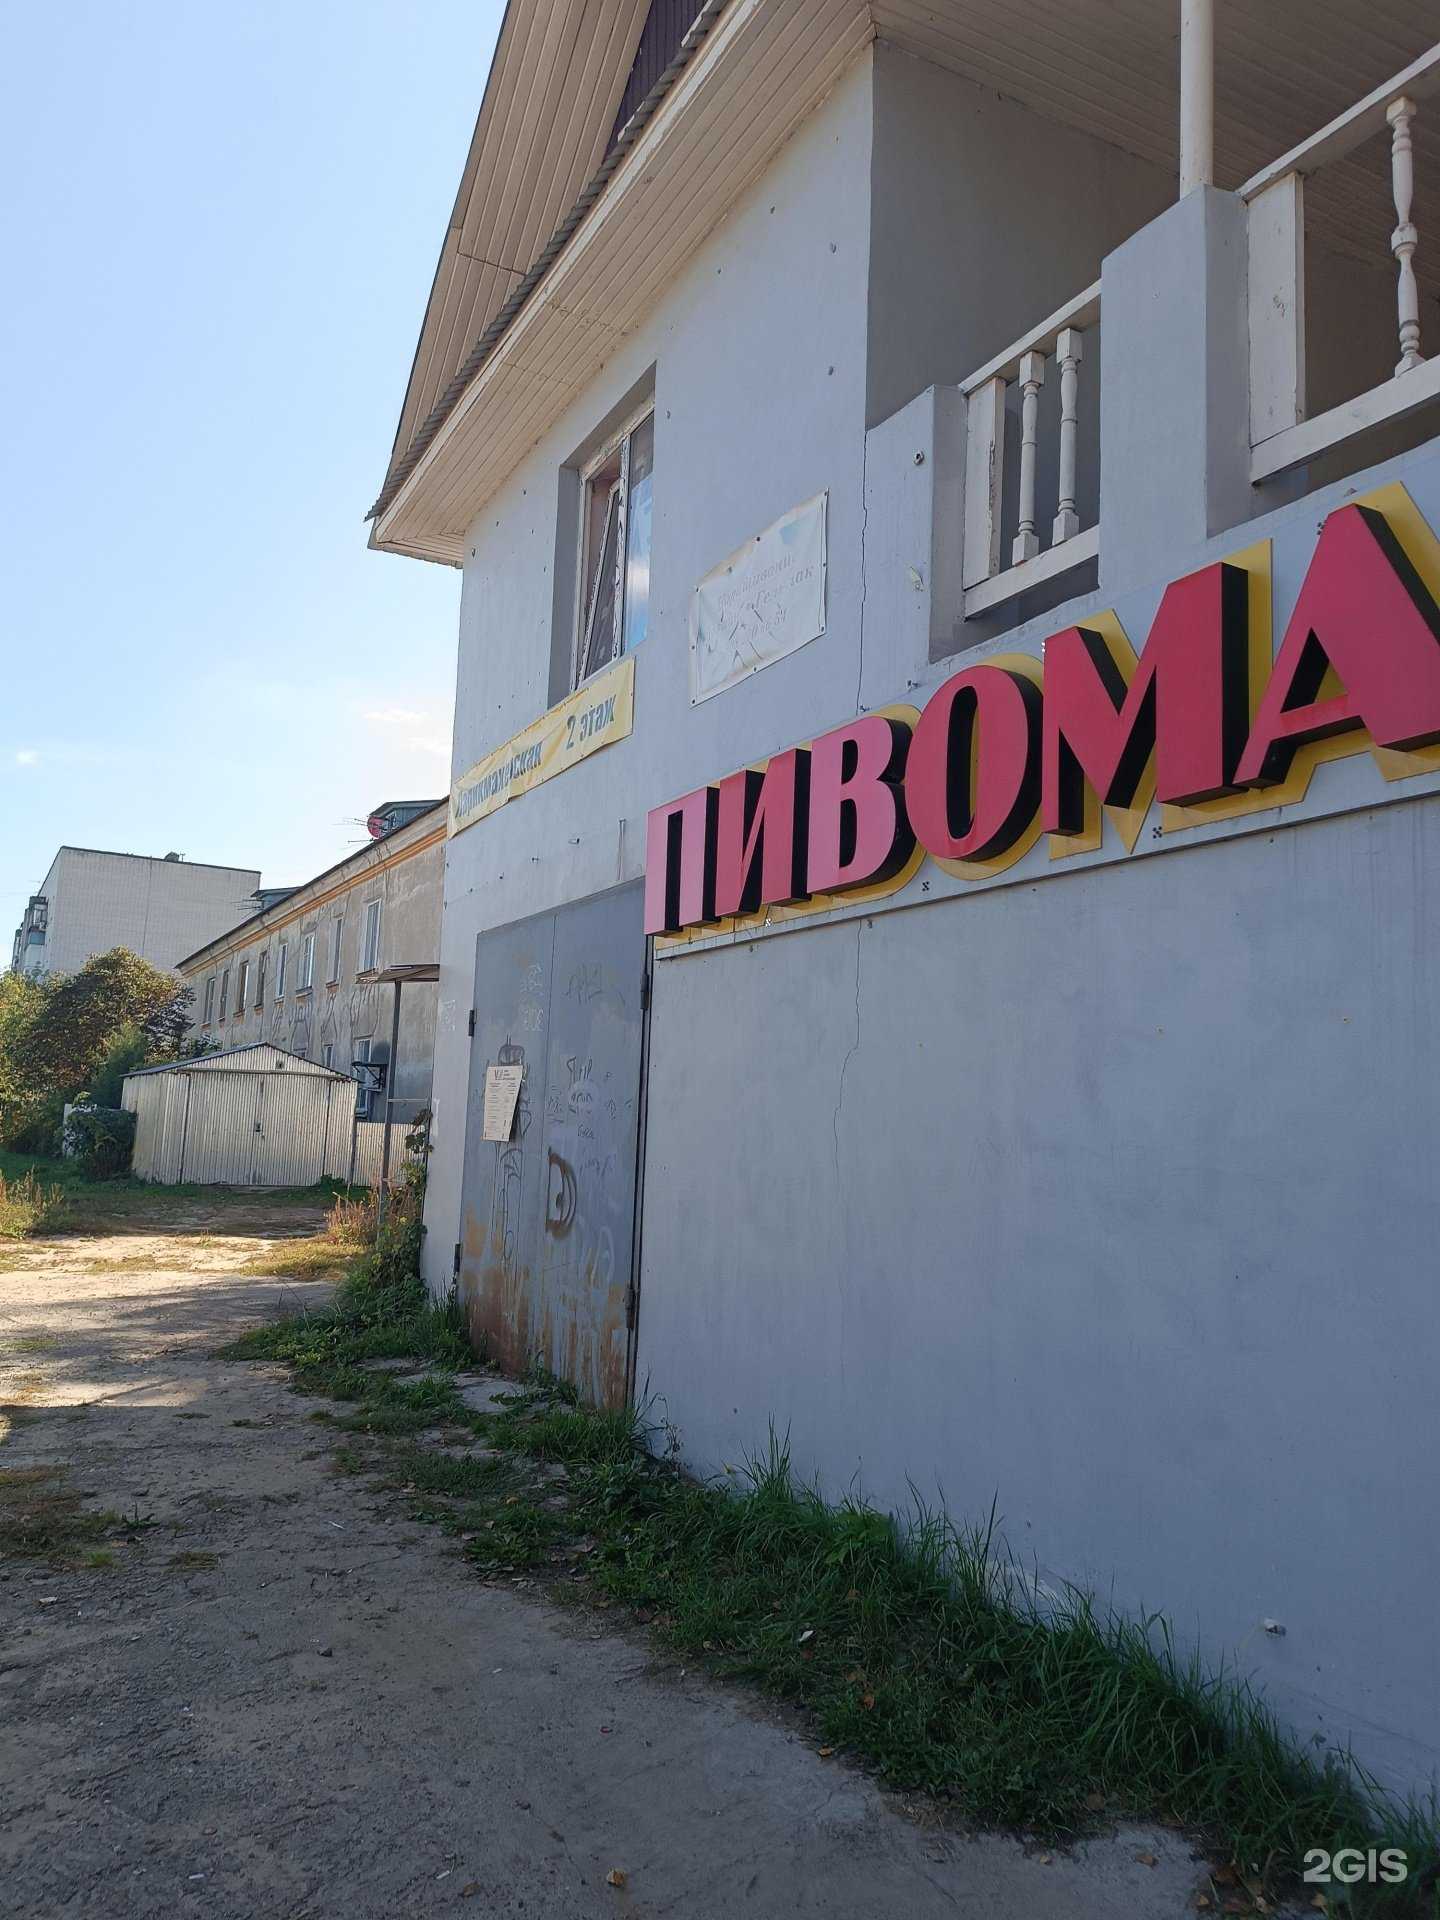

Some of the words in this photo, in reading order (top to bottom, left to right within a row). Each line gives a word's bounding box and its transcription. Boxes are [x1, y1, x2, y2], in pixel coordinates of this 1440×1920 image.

[565, 714, 577, 750] 2
[579, 694, 617, 742] этаж
[643, 503, 1440, 937] ПИВОМА
